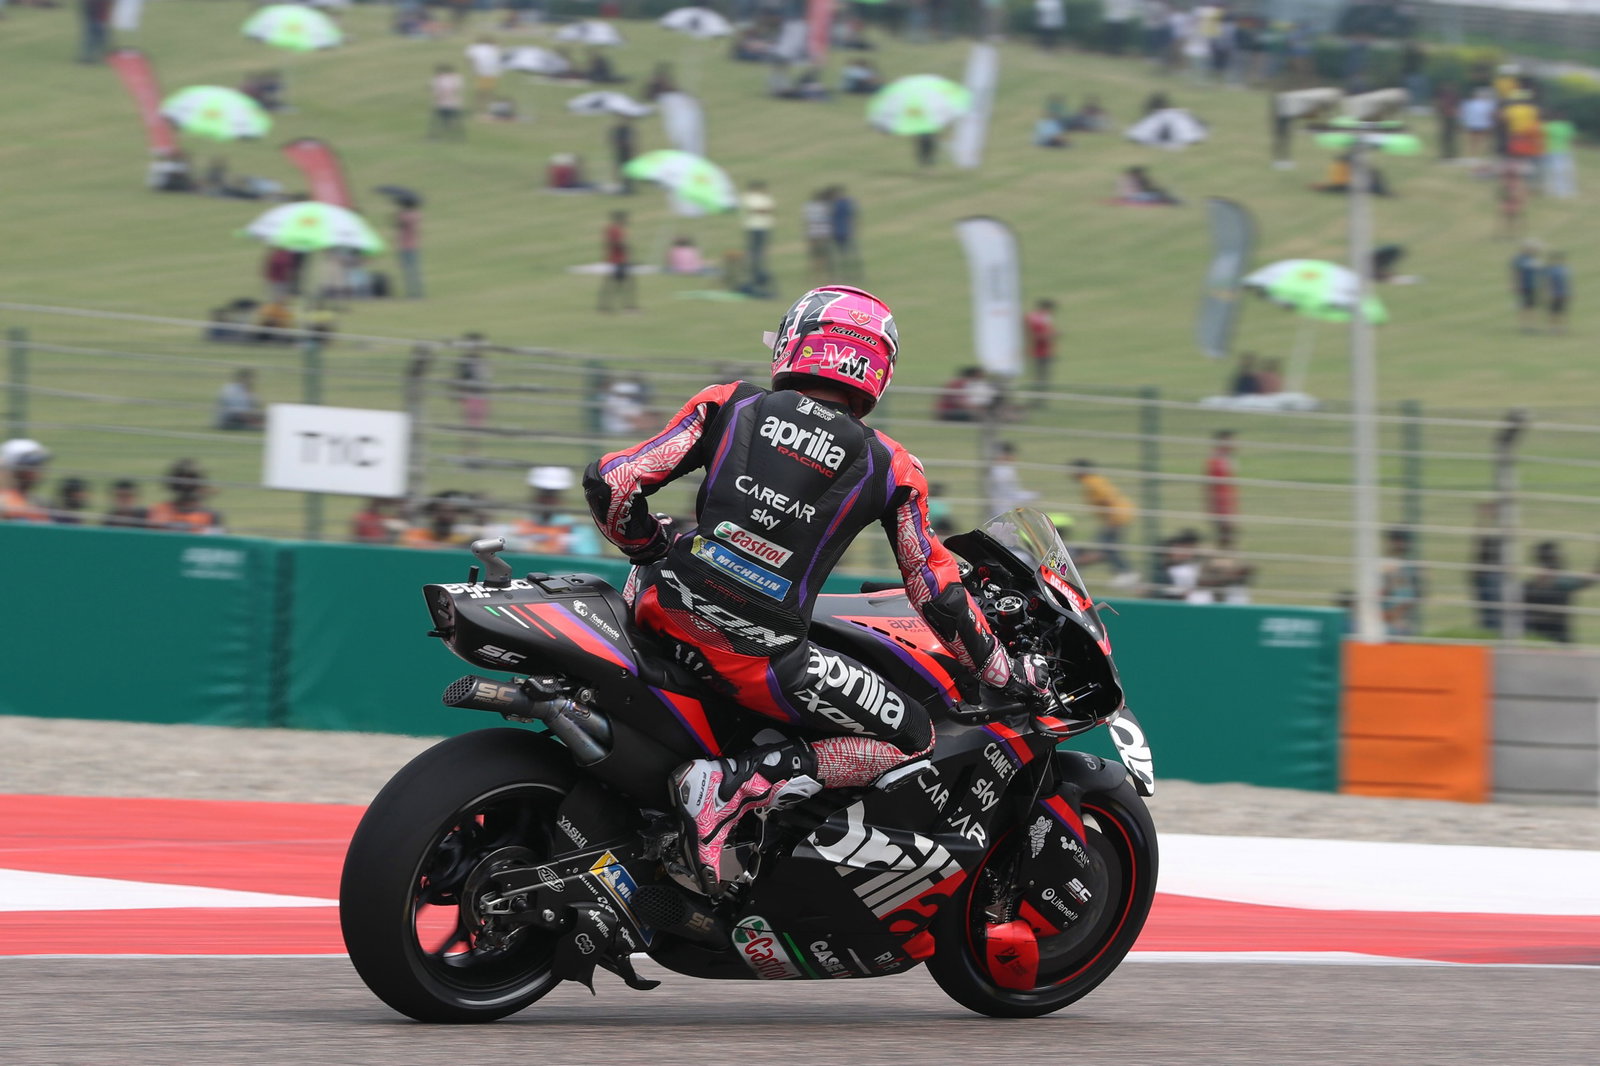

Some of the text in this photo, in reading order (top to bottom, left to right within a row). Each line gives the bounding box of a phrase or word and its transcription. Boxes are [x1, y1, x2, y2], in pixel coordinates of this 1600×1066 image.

[759, 415, 847, 472] aprilia
[776, 445, 837, 479] RACING
[734, 474, 817, 524] CAREAR
[749, 507, 782, 531] sky
[730, 530, 787, 566] Castrol
[715, 554, 781, 592] MICHELIN
[887, 617, 927, 632] apri
[806, 645, 906, 731] aprilia
[971, 778, 1000, 812] sky
[744, 936, 796, 980] Castrol
